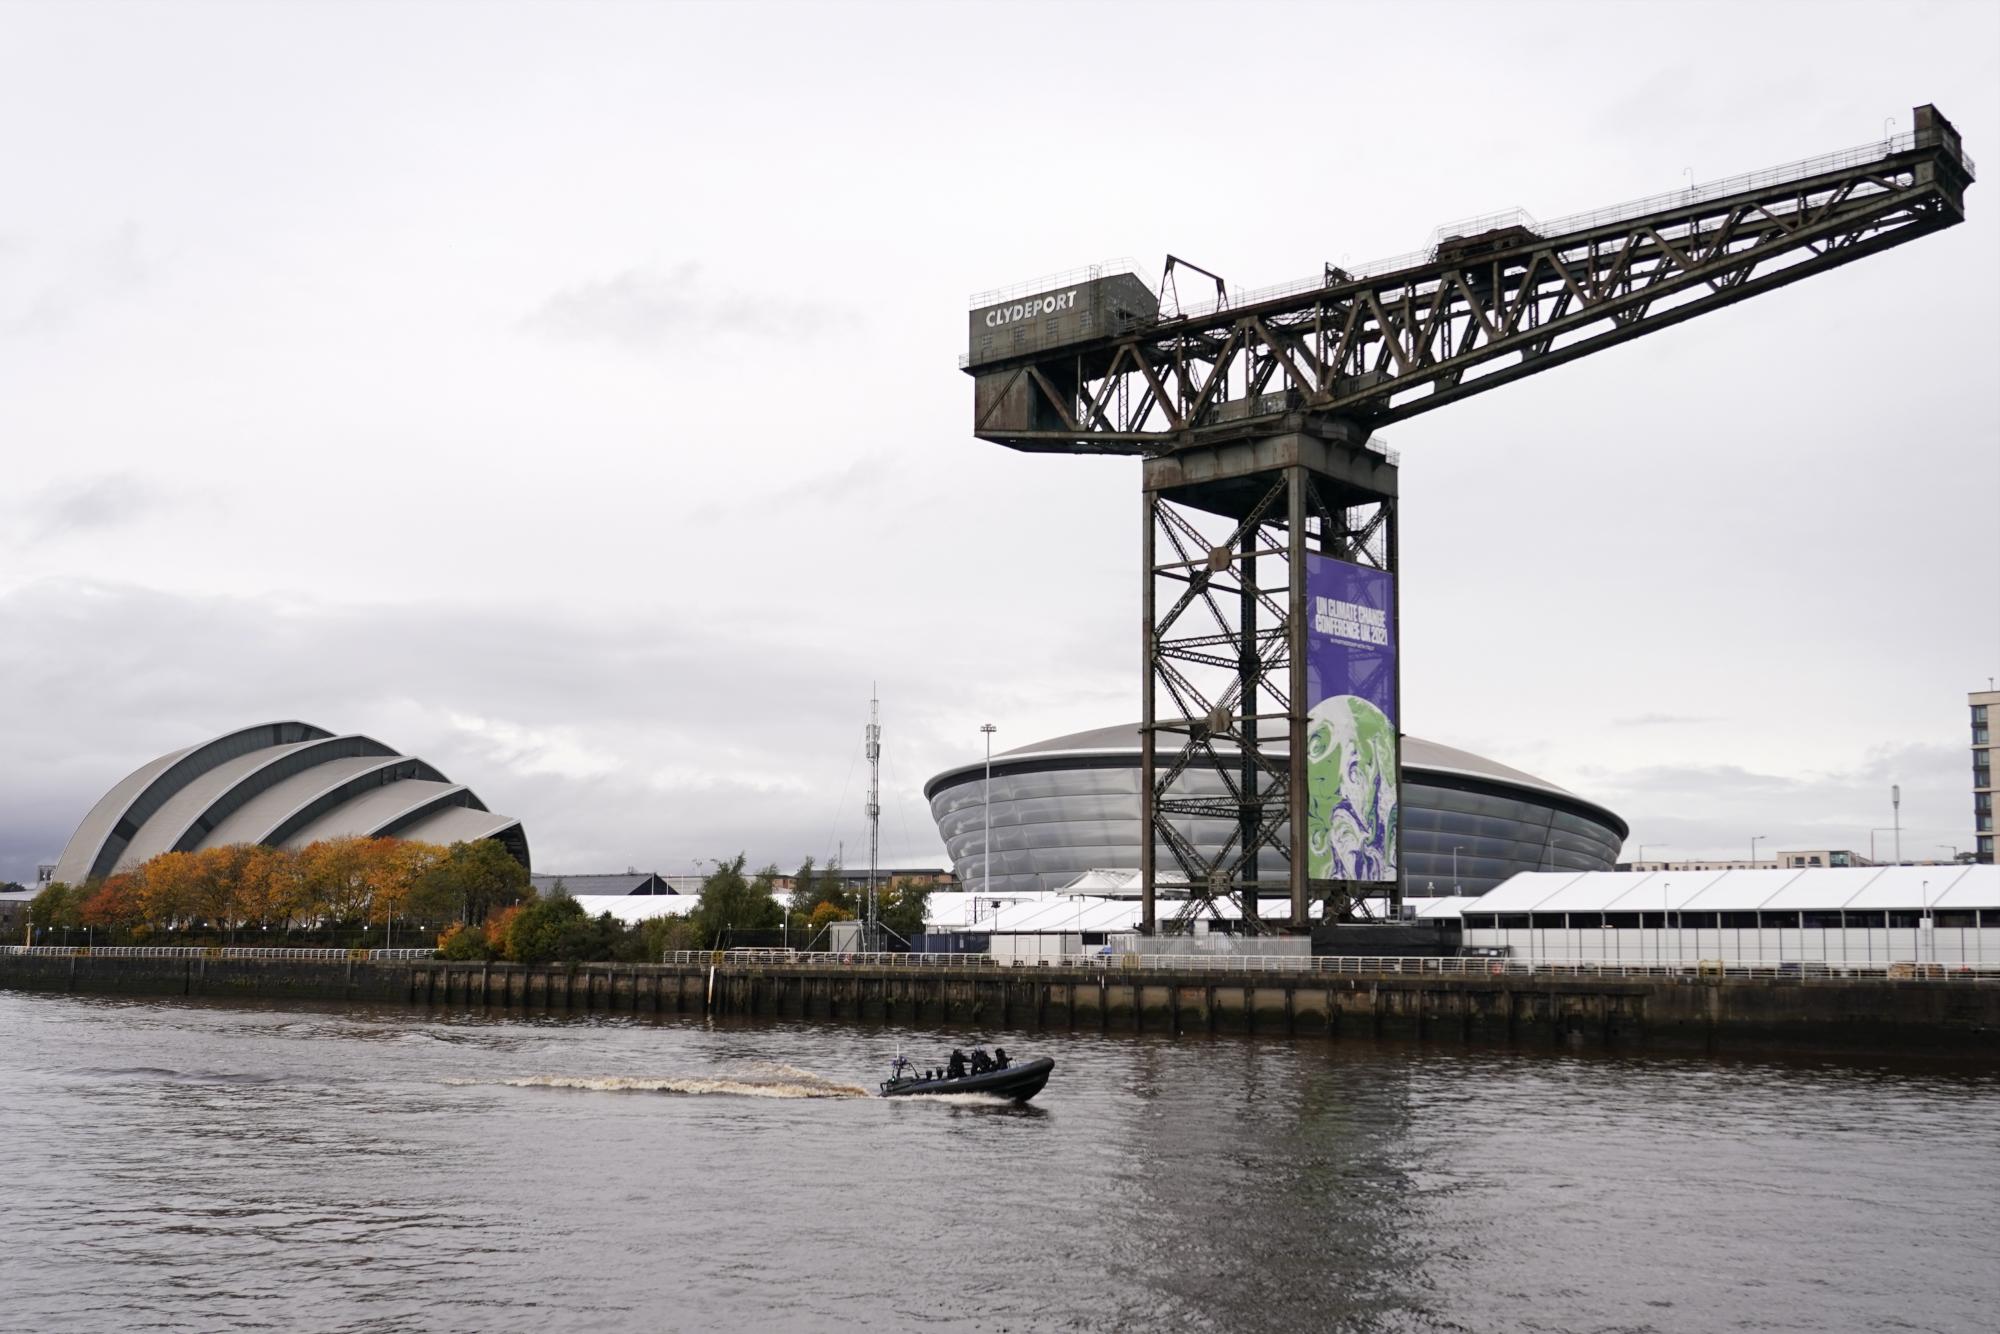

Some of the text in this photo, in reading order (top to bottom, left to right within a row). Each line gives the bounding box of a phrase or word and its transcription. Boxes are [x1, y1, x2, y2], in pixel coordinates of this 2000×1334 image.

[986, 290, 1077, 327] CLYDEPORT
[1316, 596, 1386, 628] UN CLIMATE CHANGE
[1316, 614, 1360, 640] CONFERENCE
[1361, 623, 1371, 642] UK
[1371, 626, 1388, 646] 2021
